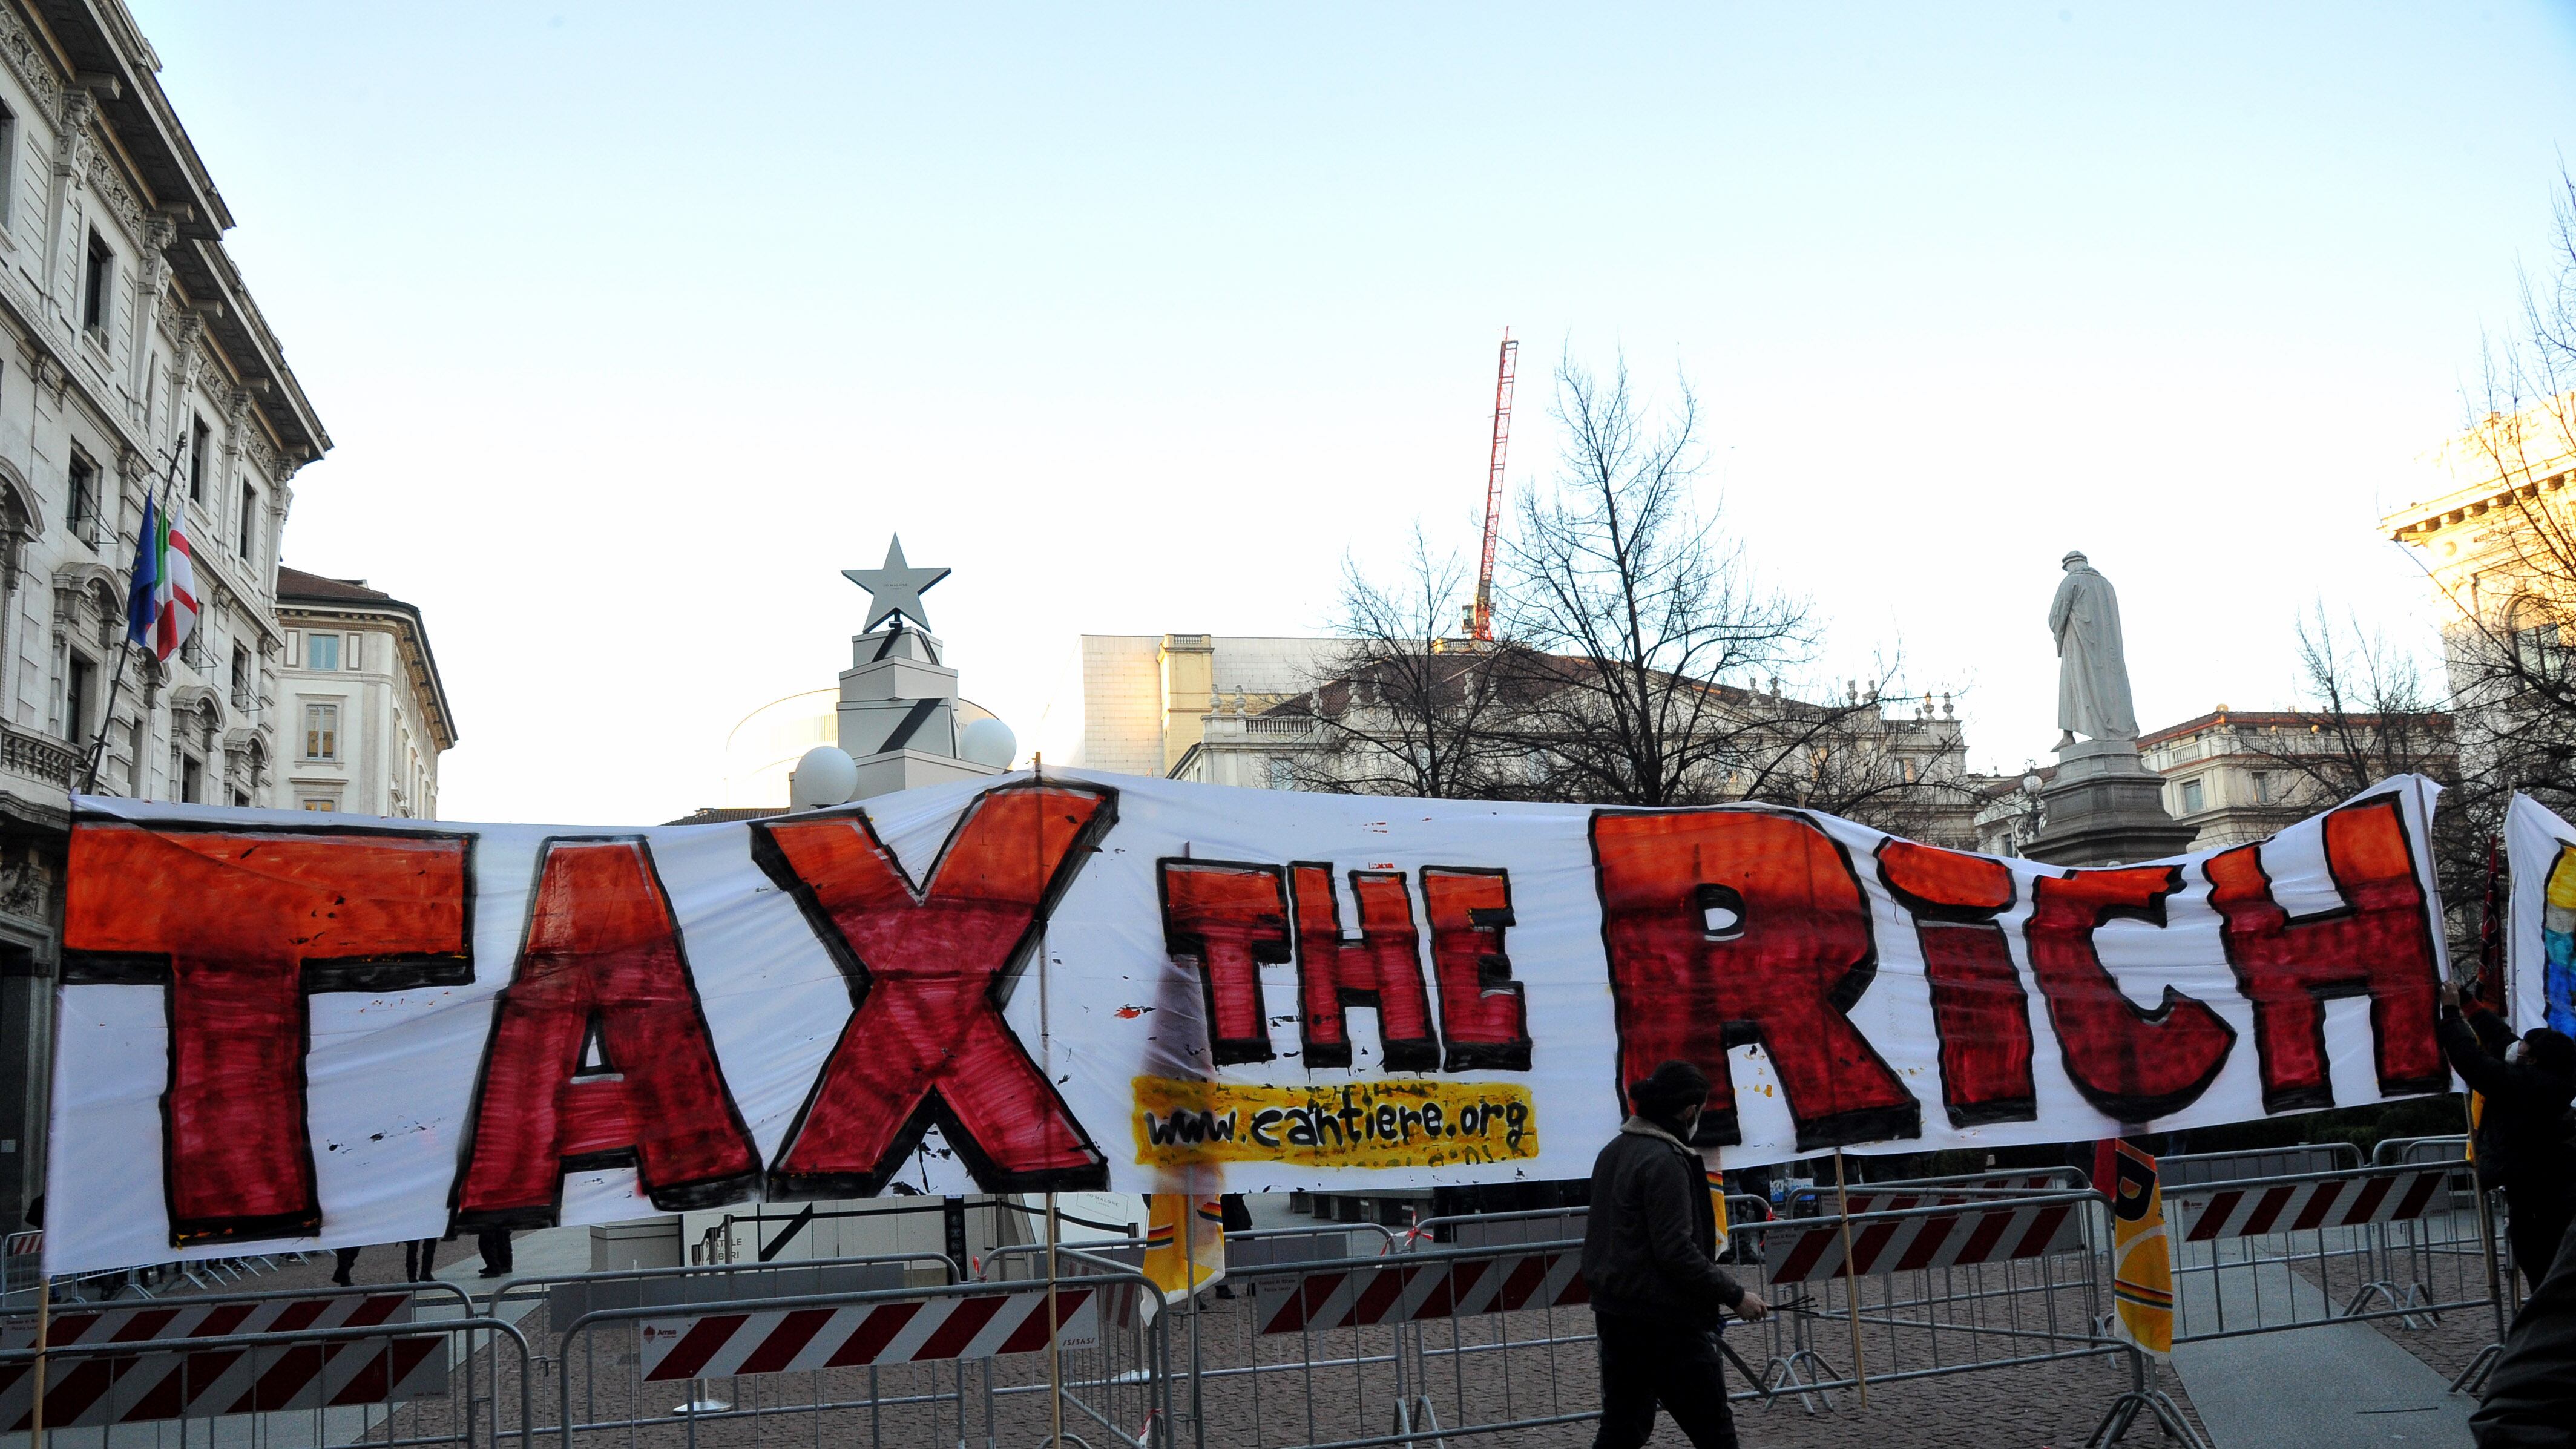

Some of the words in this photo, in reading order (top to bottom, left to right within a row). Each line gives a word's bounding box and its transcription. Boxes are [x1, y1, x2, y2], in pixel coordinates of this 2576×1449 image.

[62, 778, 1120, 1247] TAX
[1155, 857, 1534, 1071] THE
[1144, 1087, 1530, 1149] www.cantiere.org
[1094, 1196, 1119, 1207] MALONE
